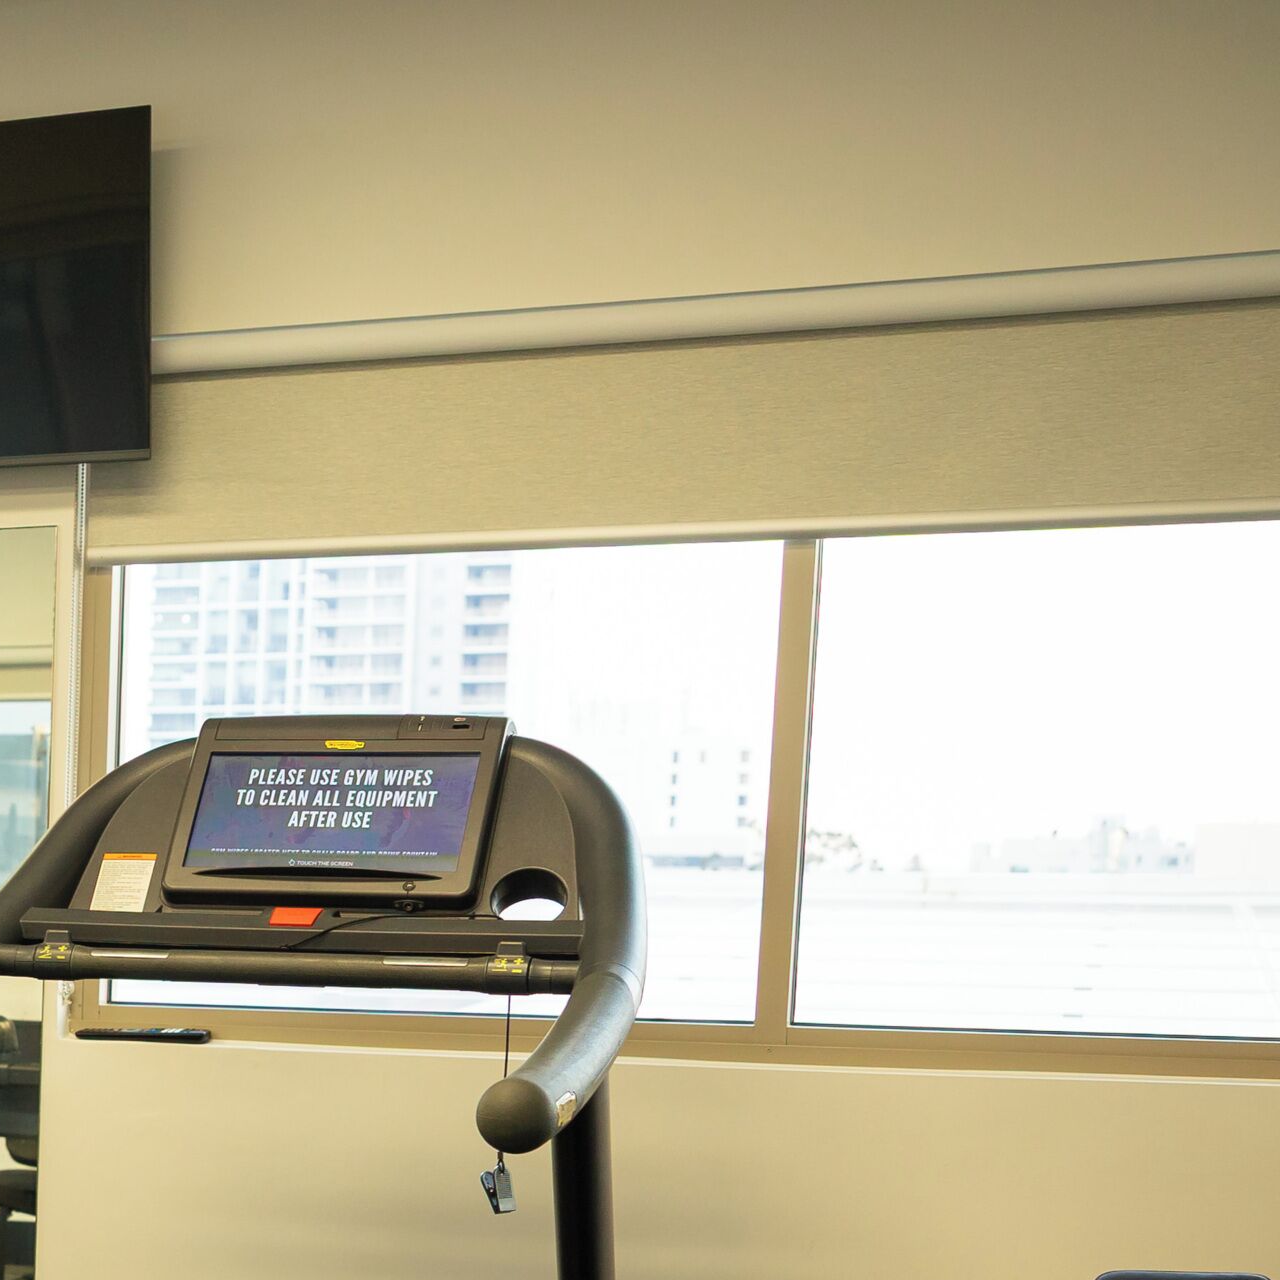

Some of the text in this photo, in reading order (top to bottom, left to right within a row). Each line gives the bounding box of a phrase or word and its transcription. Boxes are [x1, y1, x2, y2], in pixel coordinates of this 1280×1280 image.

[248, 768, 434, 786] PLEASE USE GYM WIPES
[237, 789, 438, 808] TO CLEAN ALL EQUIPMENT
[288, 810, 373, 829] AFTER USE
